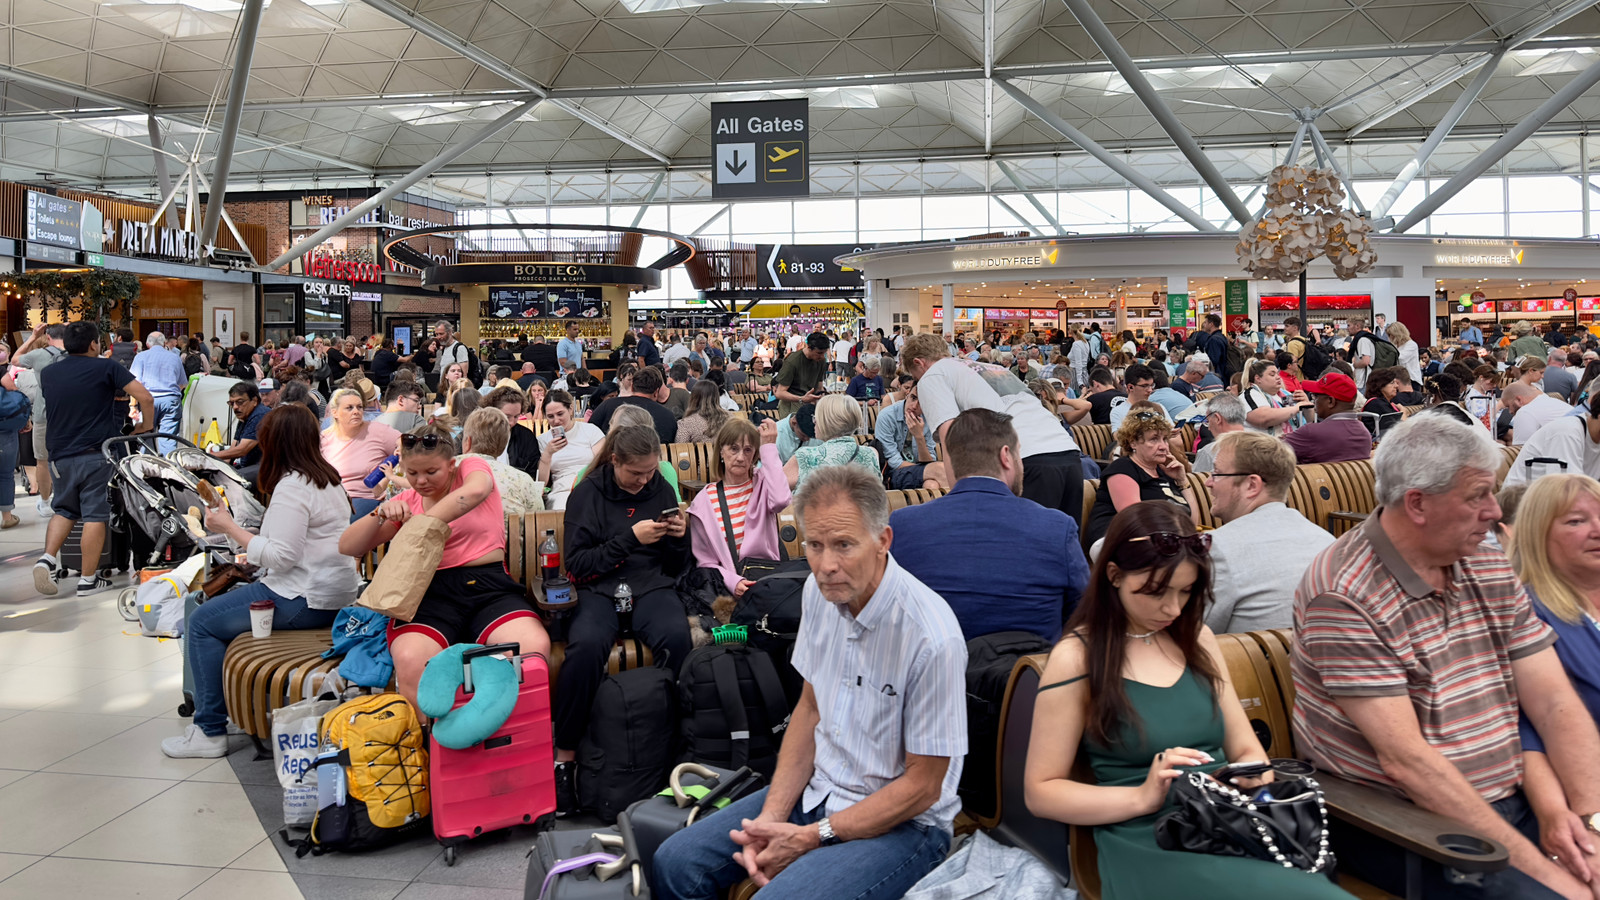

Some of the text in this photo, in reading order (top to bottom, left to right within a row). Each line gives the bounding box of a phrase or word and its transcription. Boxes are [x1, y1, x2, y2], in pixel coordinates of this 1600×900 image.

[716, 117, 804, 134] All Gates
[37, 197, 67, 213] All gates
[301, 195, 333, 206] WINES
[37, 213, 55, 225] Toilets
[388, 210, 404, 226] bar
[37, 229, 76, 245] Escape lounge
[121, 218, 200, 260] PRET A MANGER
[303, 249, 382, 288] Wetherspoon
[514, 265, 587, 276] BOTTEGA
[790, 262, 825, 273] 81-93
[303, 282, 327, 295] CASK
[329, 284, 351, 297] ALES
[278, 732, 318, 751] Reus
